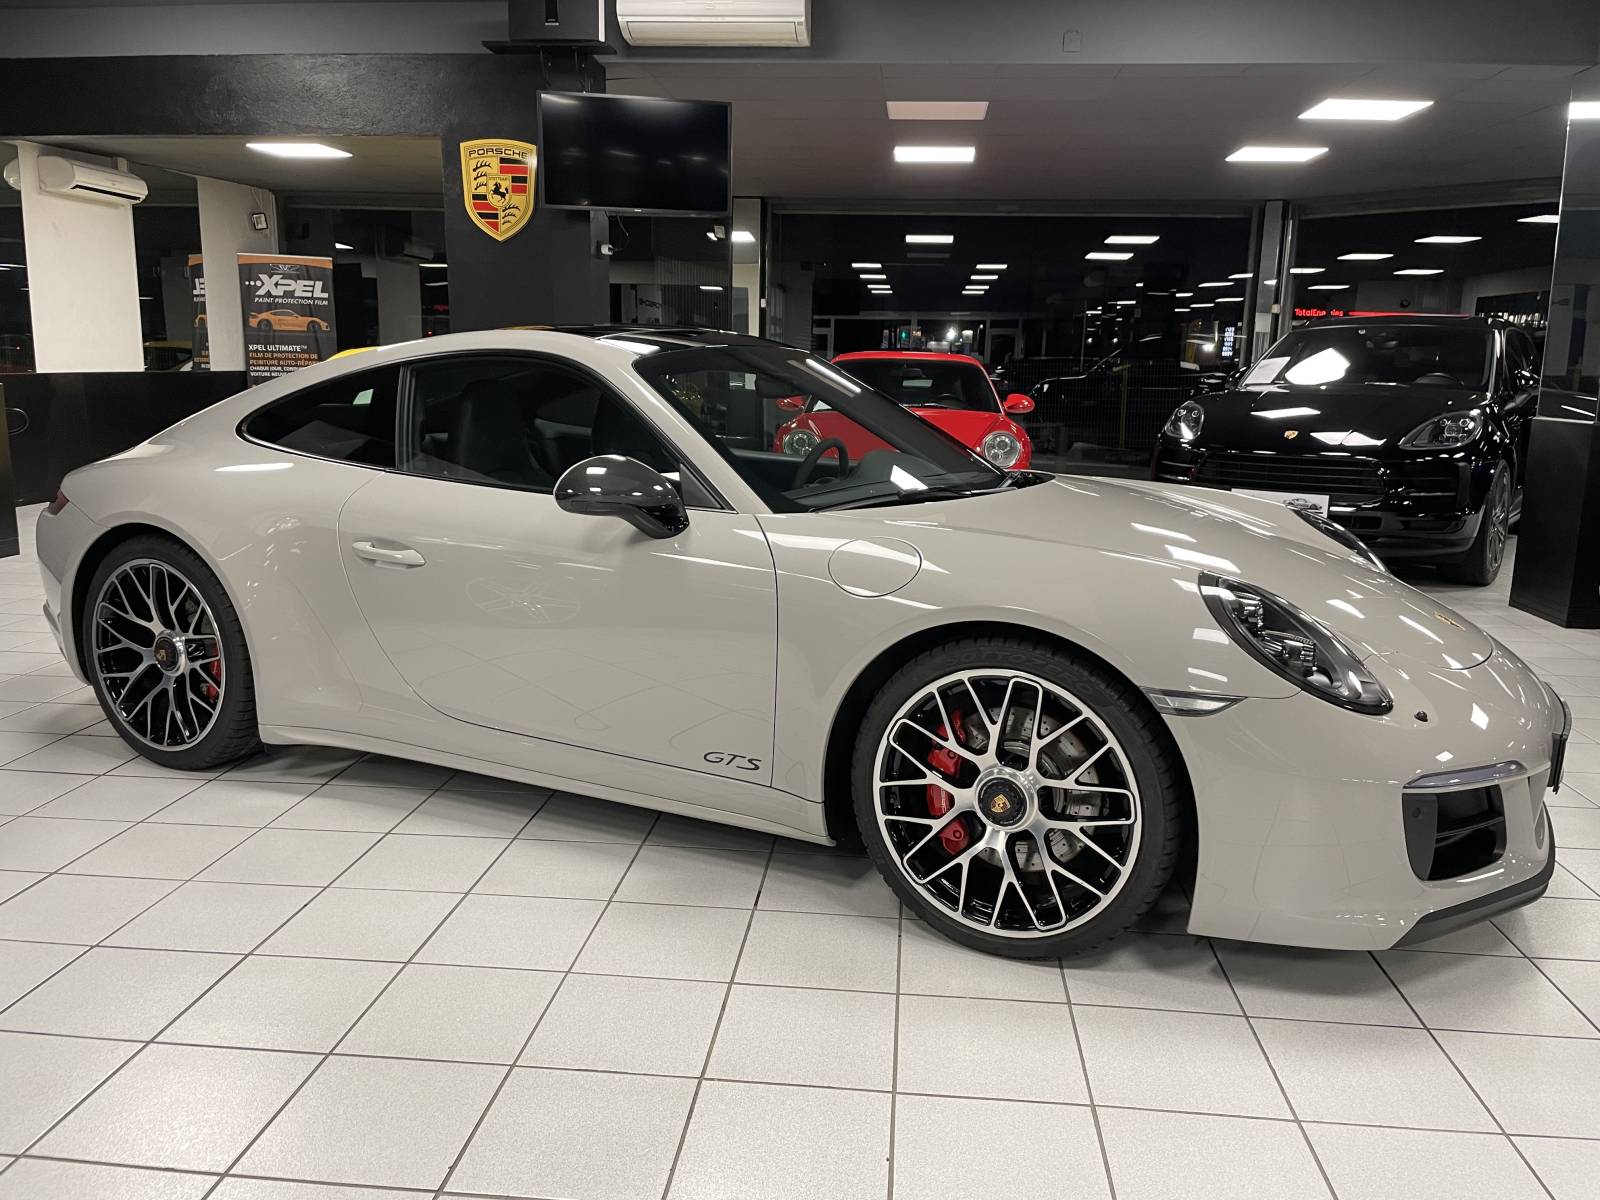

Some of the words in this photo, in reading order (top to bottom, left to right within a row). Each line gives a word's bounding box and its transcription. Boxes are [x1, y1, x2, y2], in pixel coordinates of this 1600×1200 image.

[468, 148, 528, 159] PORSCHE
[256, 274, 329, 298] XPEL
[703, 751, 762, 771] GTS
